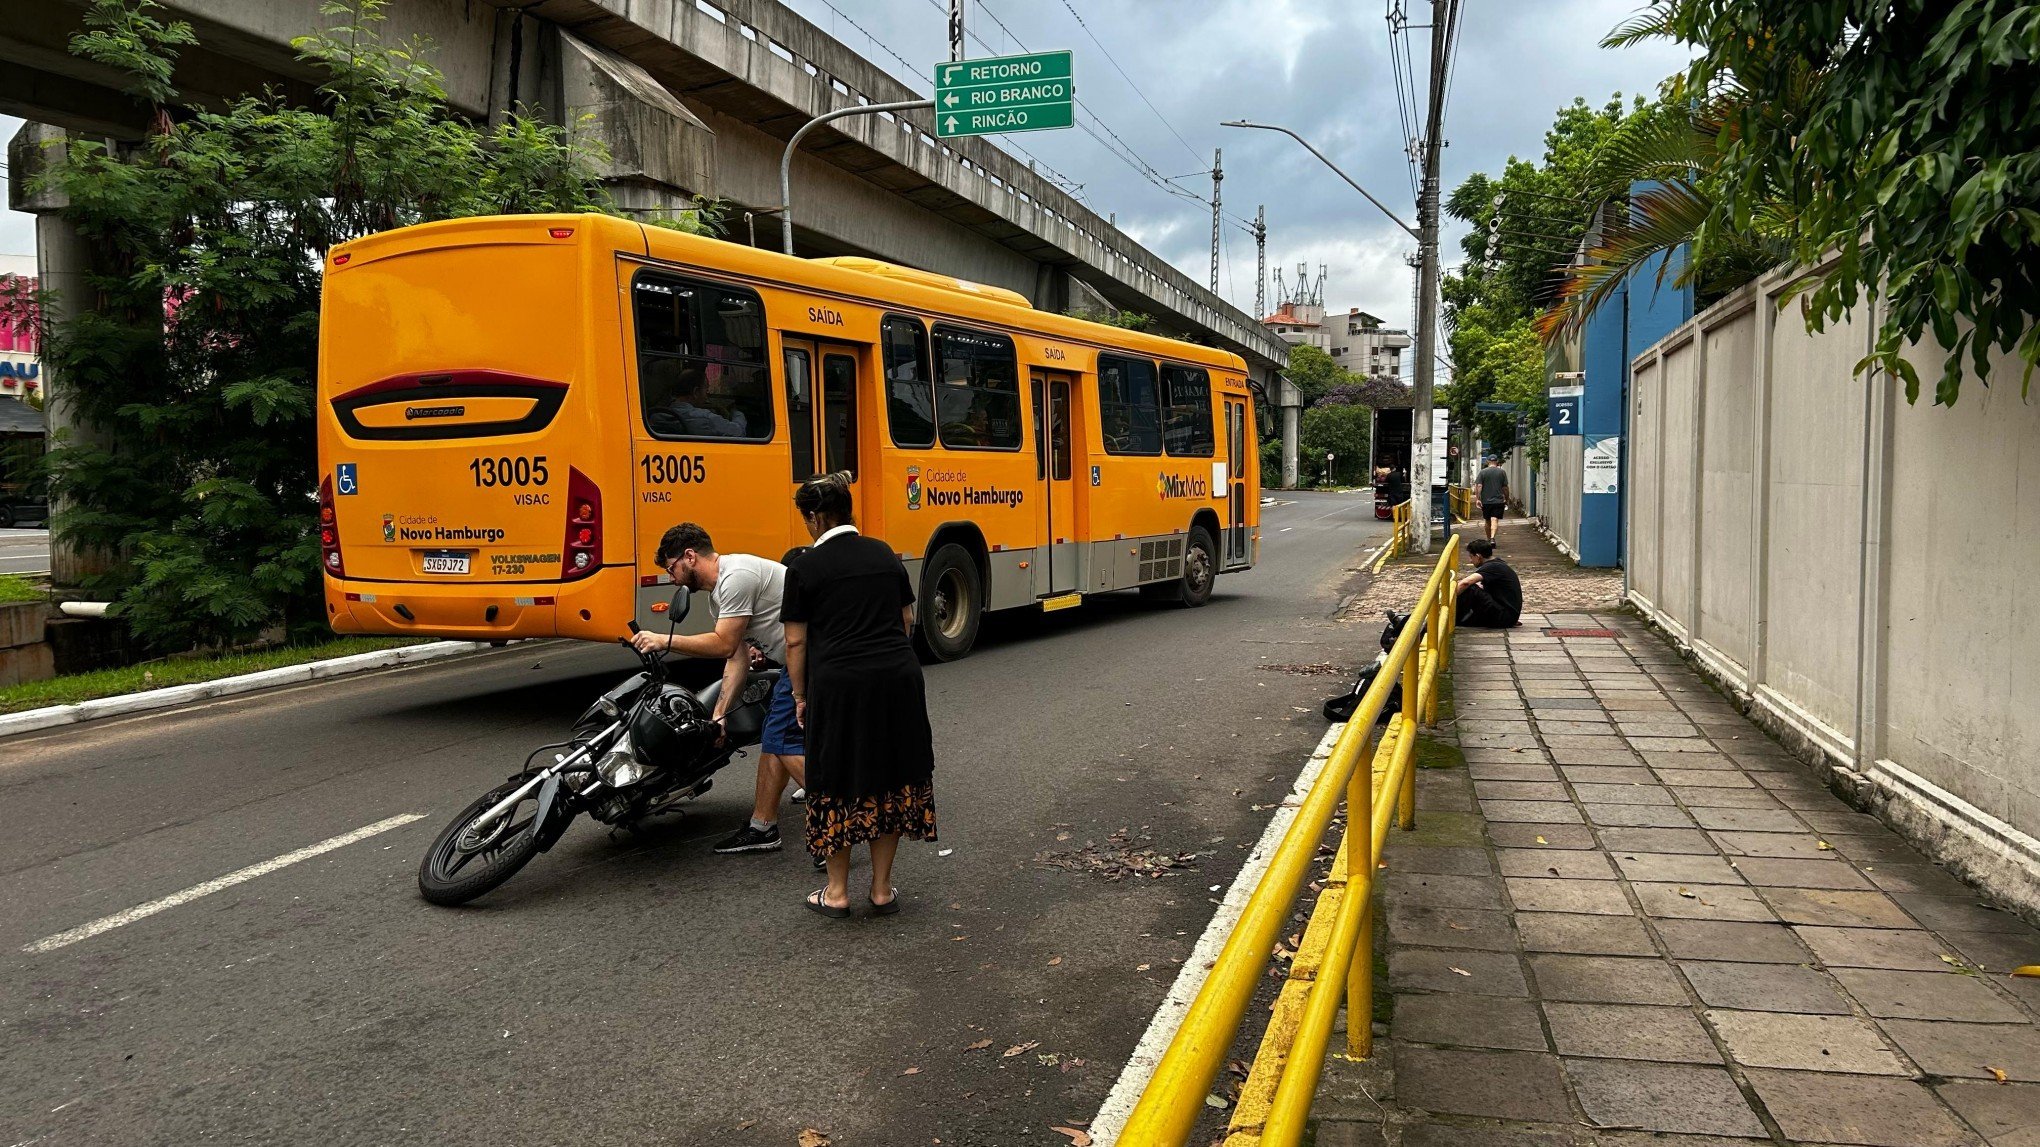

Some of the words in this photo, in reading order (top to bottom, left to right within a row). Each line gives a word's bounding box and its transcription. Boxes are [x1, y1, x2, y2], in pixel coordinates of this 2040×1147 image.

[970, 61, 1042, 80] RETORNO
[971, 90, 996, 105] RIO
[1000, 84, 1064, 102] BRANCO
[972, 110, 1028, 129] RINCÃO
[808, 305, 844, 327] SAÍDA
[1044, 345, 1066, 362] SAÍDA
[1225, 377, 1245, 389] ENTRADA
[413, 408, 464, 416] Marcopolo
[1559, 409, 1570, 424] 2
[469, 456, 549, 487] 13005
[640, 454, 706, 483] 13005
[926, 468, 955, 482] Cidade
[956, 469, 967, 482] de
[1166, 473, 1206, 498] MixMob
[513, 493, 550, 505] VISAC
[642, 491, 672, 502] VISAC
[926, 487, 961, 506] Novo
[963, 486, 1024, 508] Hamburgo
[399, 515, 426, 525] Cidade
[427, 515, 438, 524] de
[400, 527, 432, 540] Novo
[434, 526, 505, 543] Hamburgo
[426, 558, 464, 571] SXG9J72
[491, 554, 561, 565] VOLKSWAGEN
[491, 565, 525, 575] 17-230
